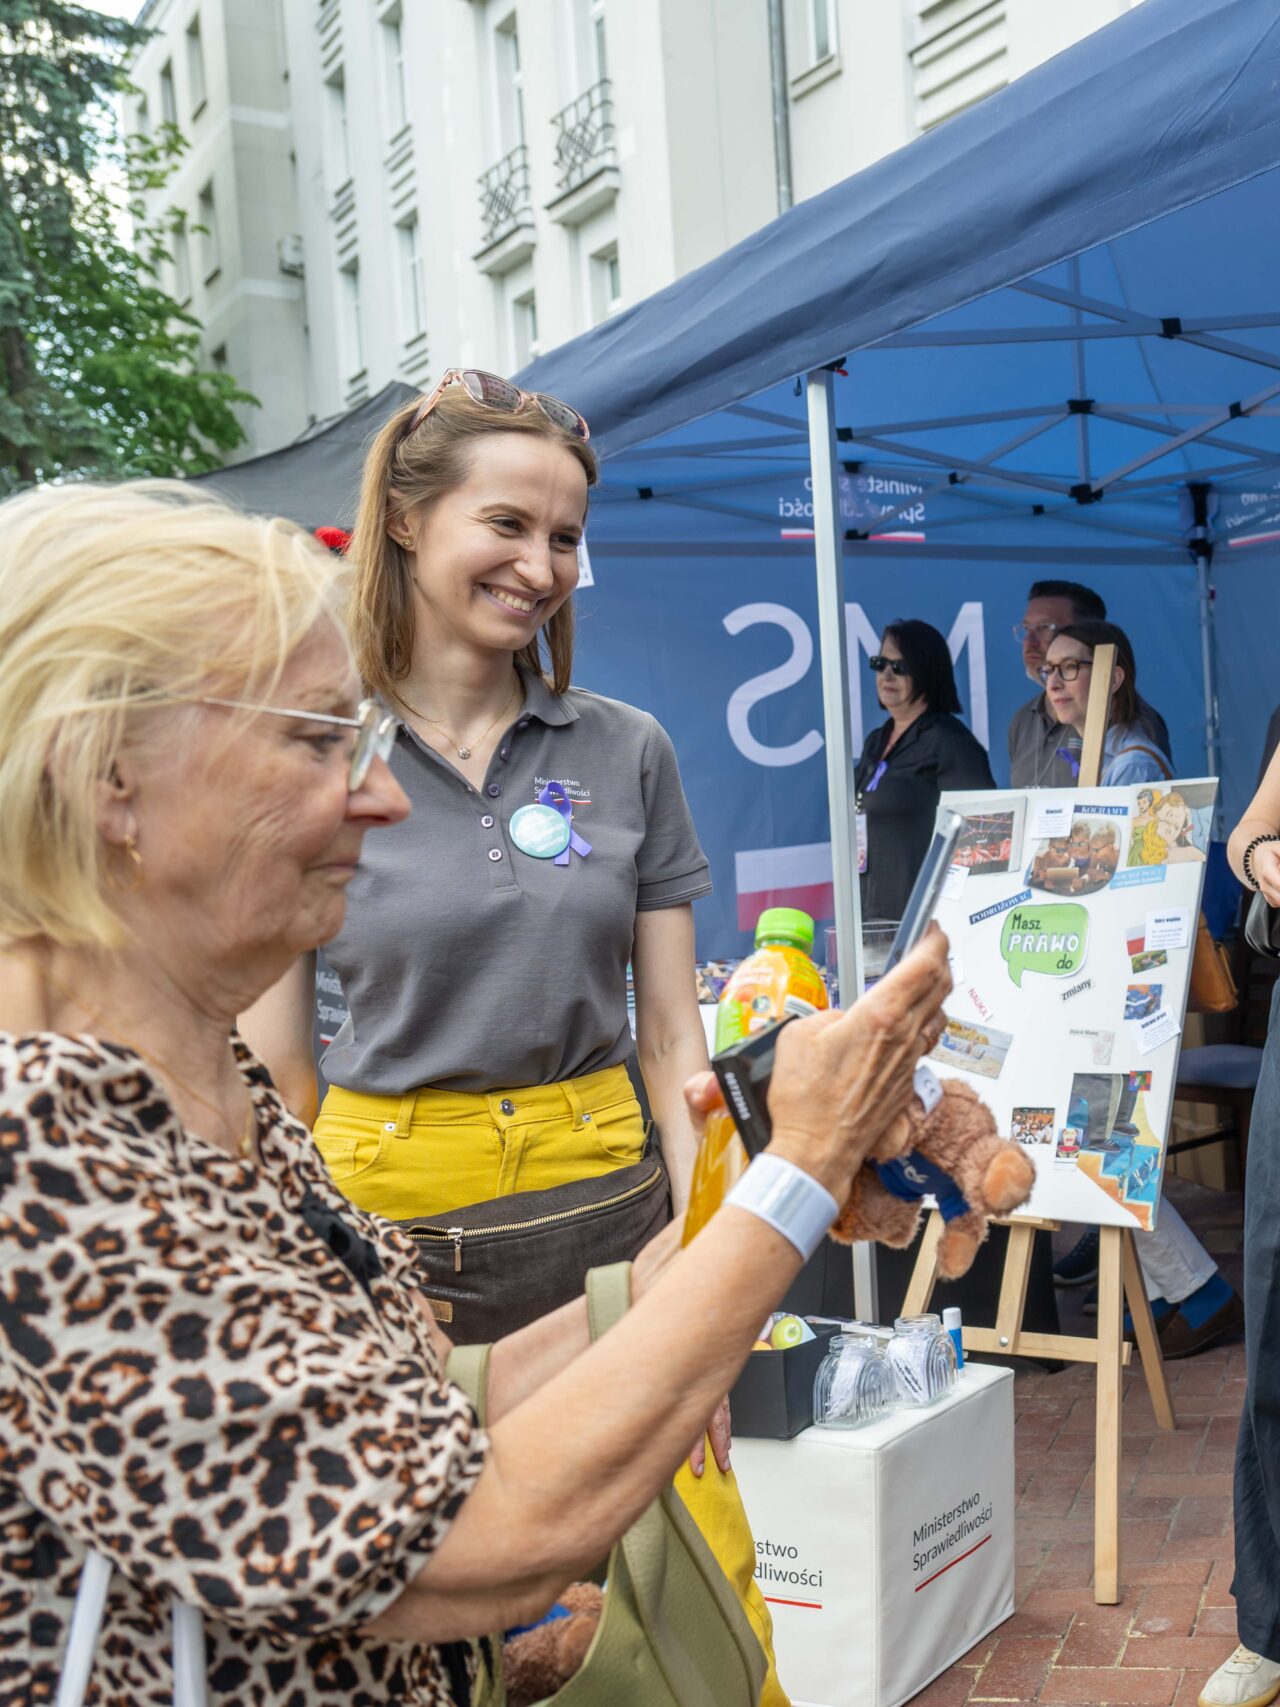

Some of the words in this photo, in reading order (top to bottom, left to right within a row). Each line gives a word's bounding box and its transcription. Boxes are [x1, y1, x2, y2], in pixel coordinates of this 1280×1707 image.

[1081, 805, 1125, 816] KOCHAMY
[1011, 913, 1042, 931] Masz
[1008, 932, 1080, 953] PRAWO
[1056, 954, 1073, 970] do
[1061, 978, 1092, 1001] zmiany
[967, 988, 988, 1018] NAUKA
[912, 1492, 981, 1548] Ministerstwo
[912, 1501, 993, 1572] Sprawiedliwości
[753, 1561, 823, 1587] dliwości
